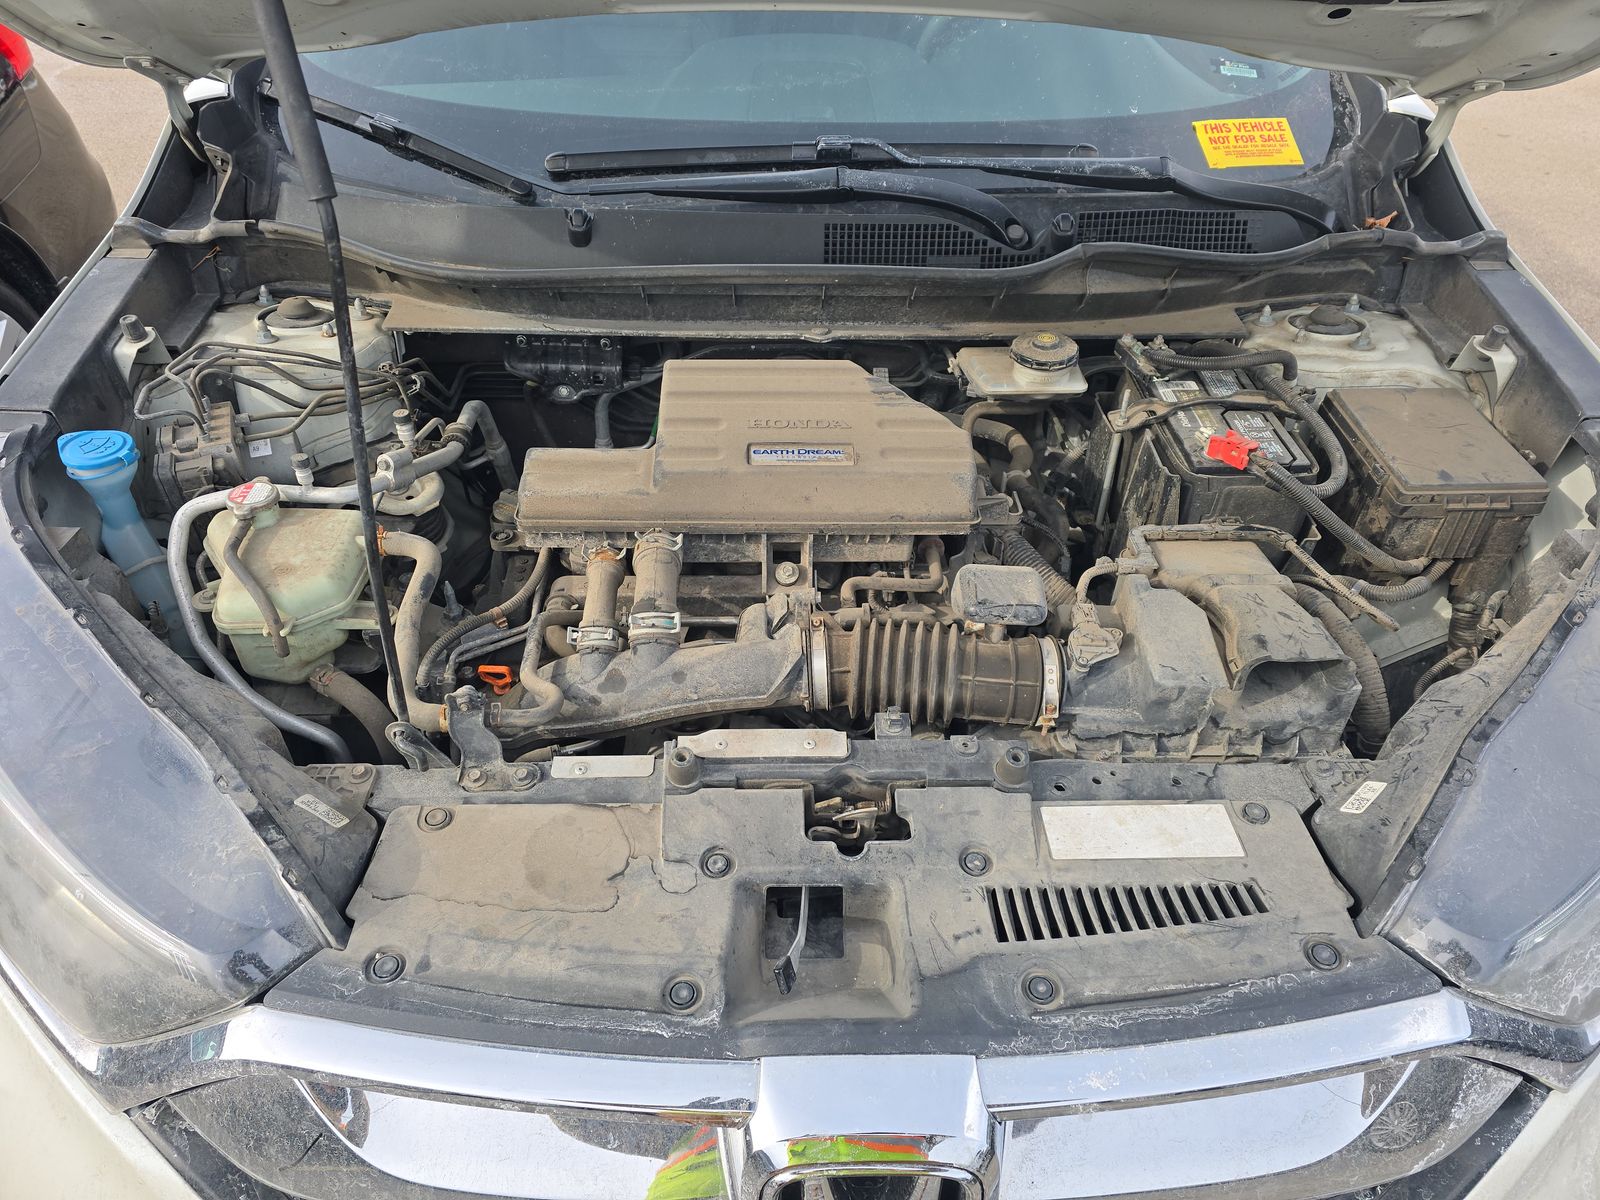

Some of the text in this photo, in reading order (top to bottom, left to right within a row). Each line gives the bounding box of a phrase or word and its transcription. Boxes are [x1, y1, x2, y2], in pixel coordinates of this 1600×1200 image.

[1203, 121, 1286, 134] THIS VEHICLE
[1208, 133, 1287, 145] NOT FOR SALE
[747, 418, 852, 429] HONDA
